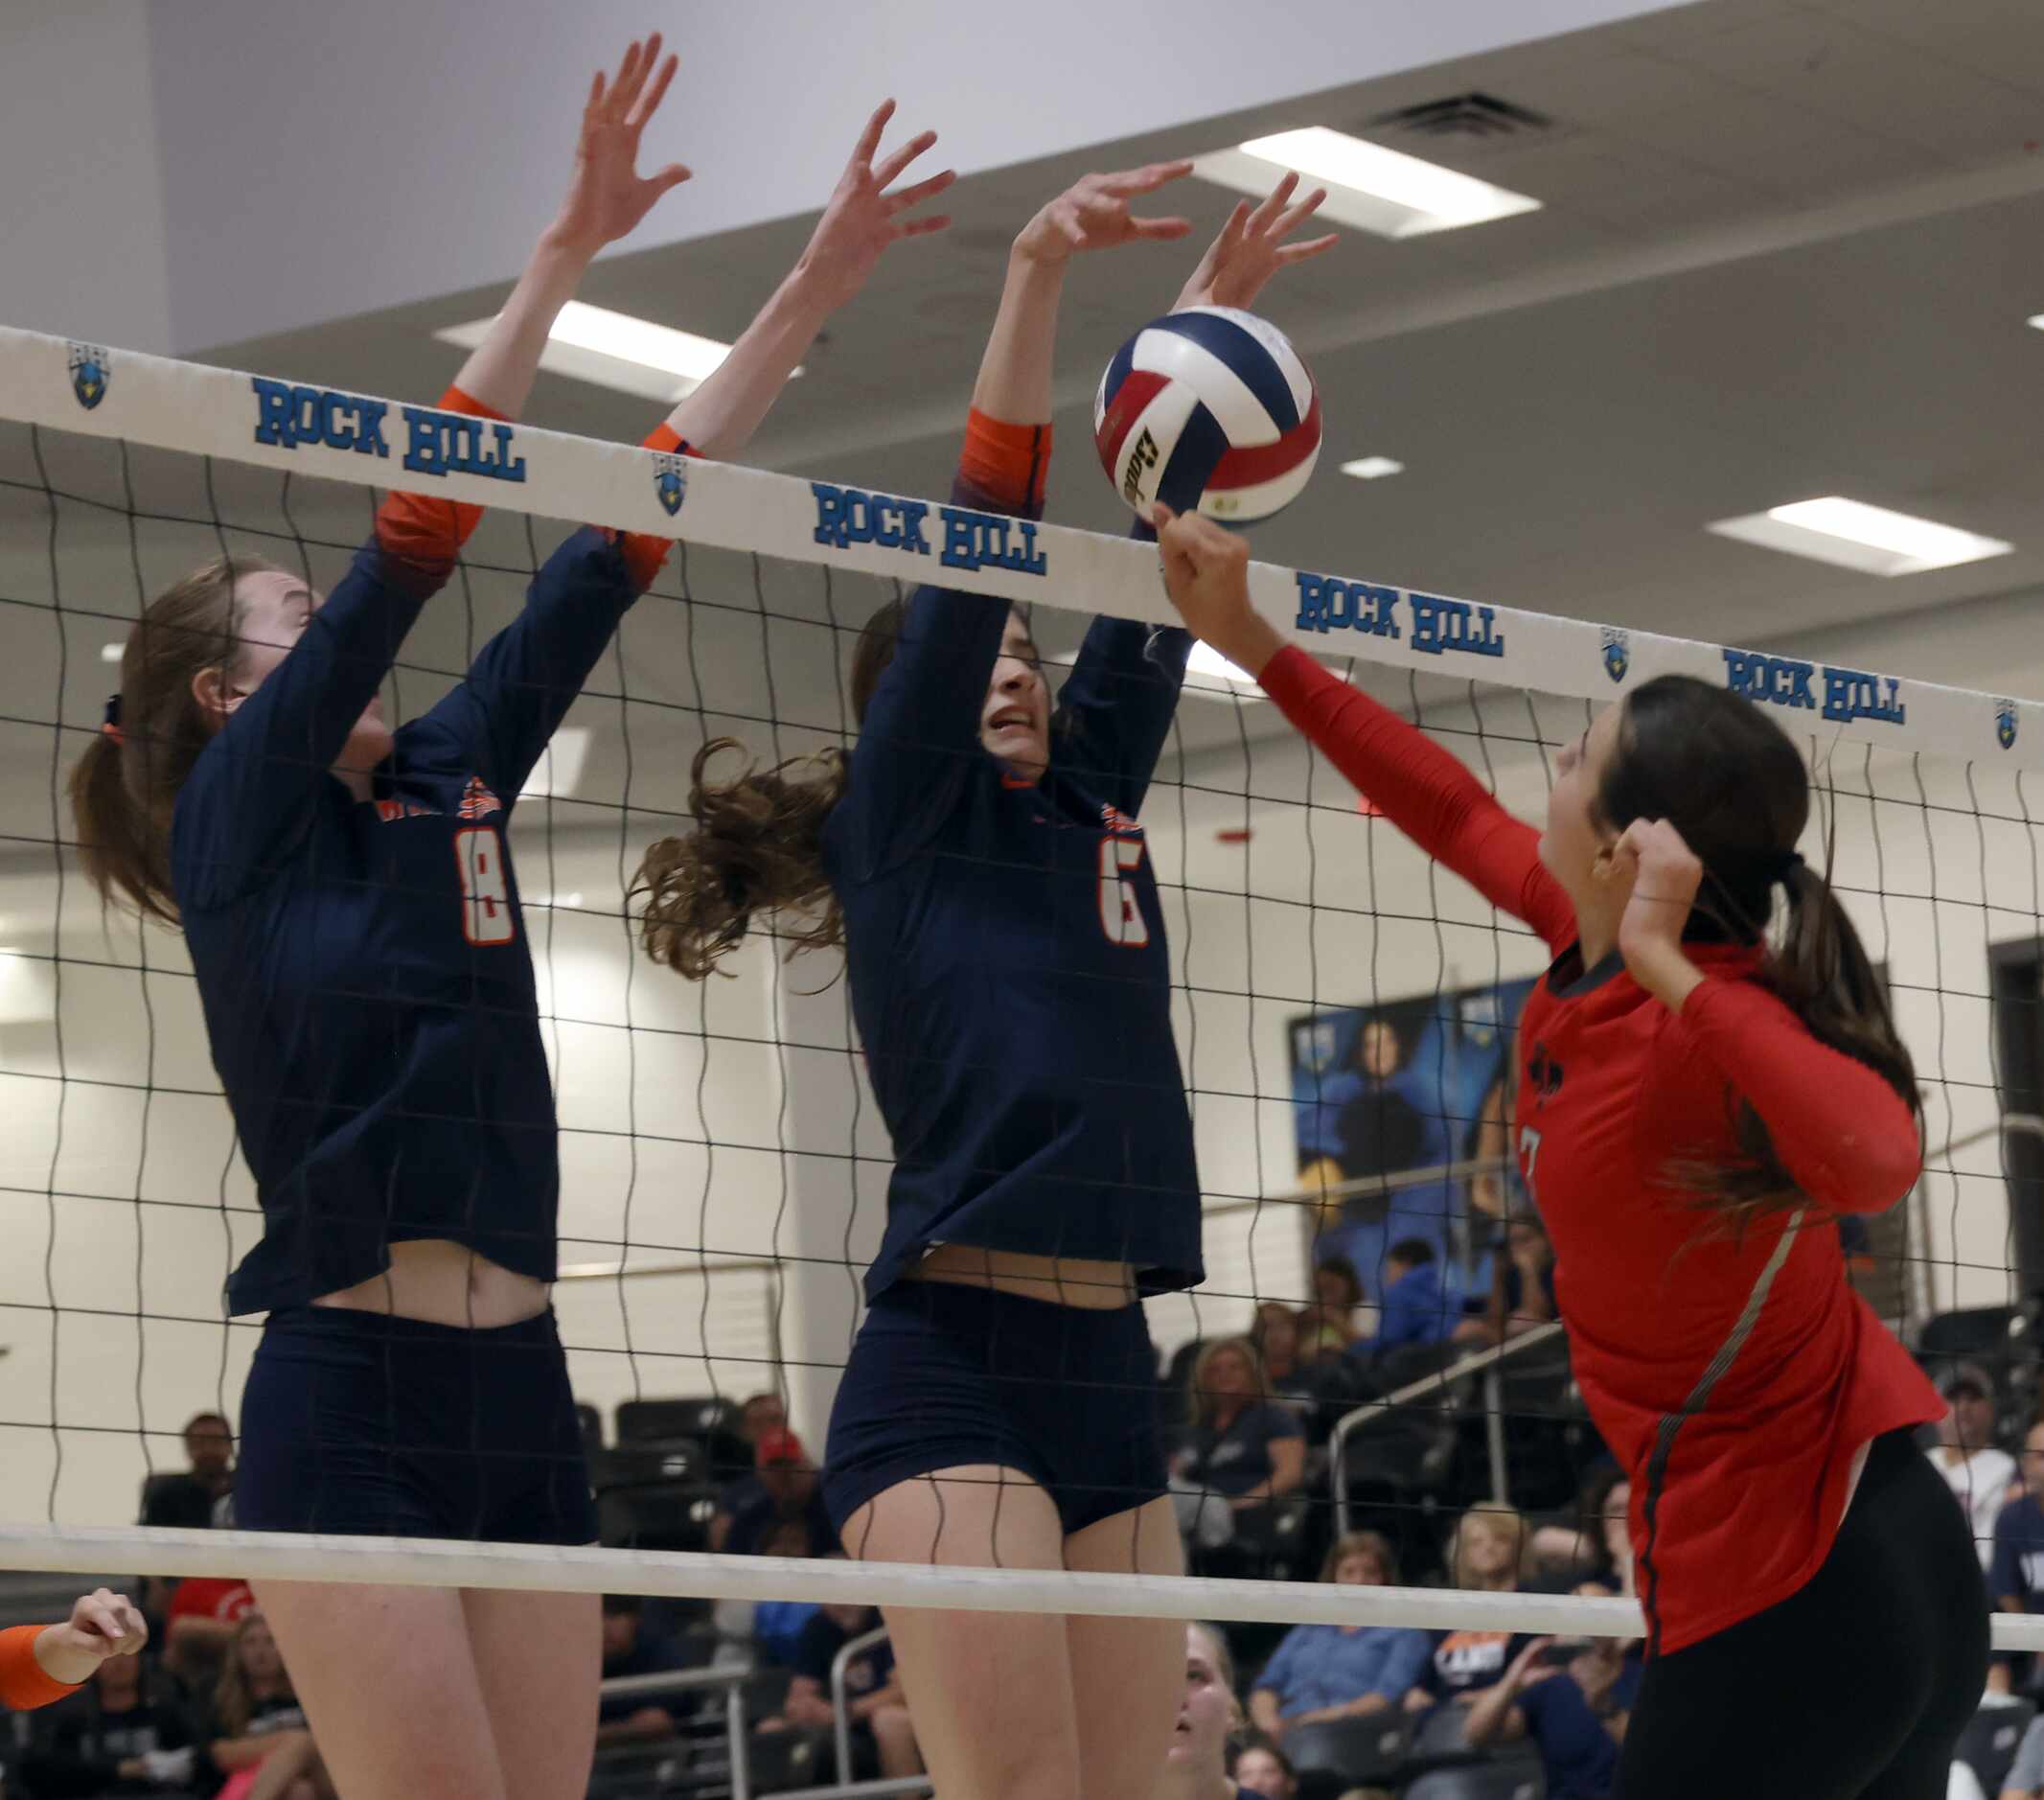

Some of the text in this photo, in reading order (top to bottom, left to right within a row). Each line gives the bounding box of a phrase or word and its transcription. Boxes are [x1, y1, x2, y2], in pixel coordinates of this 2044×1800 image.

[252, 375, 526, 482] ROCK HILL
[811, 481, 1047, 576] ROCK HILL
[1296, 569, 1504, 658] ROCK HILL
[1726, 648, 1905, 725] ROCK HILL
[454, 825, 516, 947] 8
[1097, 834, 1150, 949] 6
